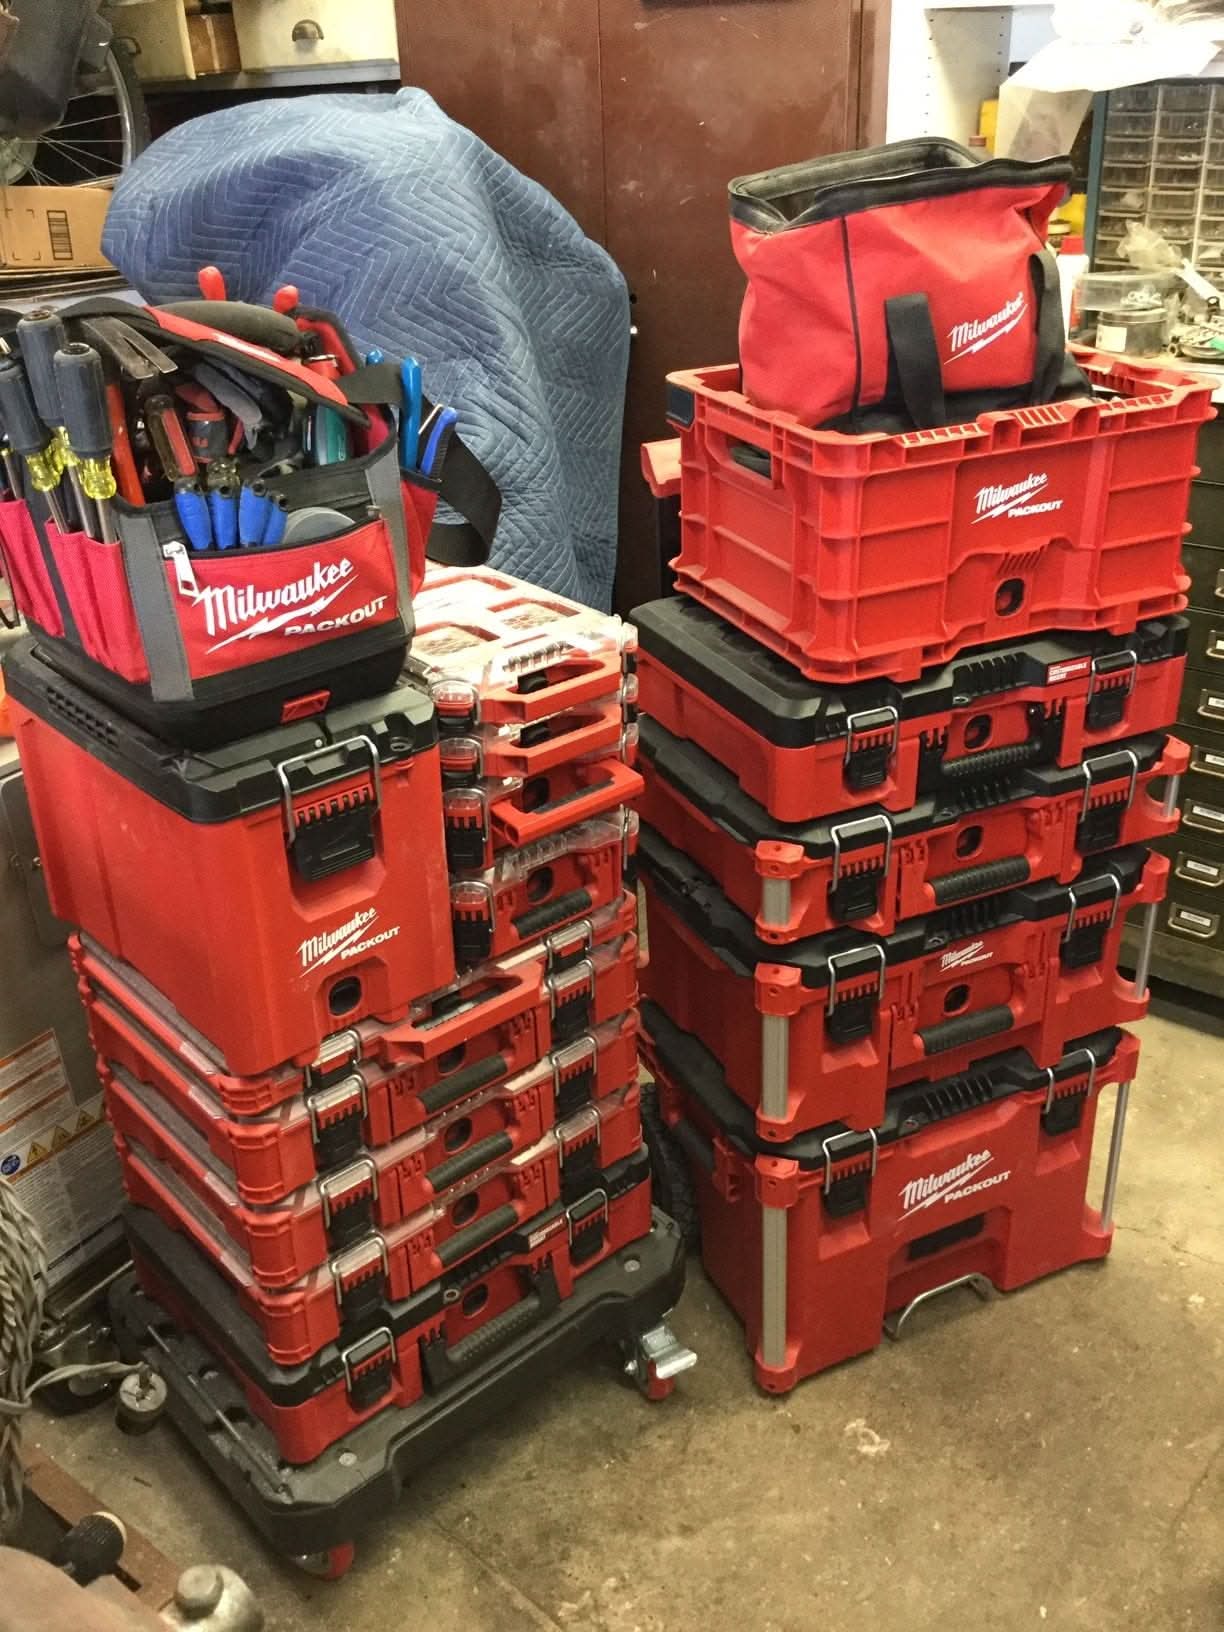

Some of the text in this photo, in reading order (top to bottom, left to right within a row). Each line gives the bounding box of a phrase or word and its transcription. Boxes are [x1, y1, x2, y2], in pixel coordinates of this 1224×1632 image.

[973, 472, 1048, 515] Milwaukee
[191, 557, 354, 636] Milwaukee
[284, 595, 388, 636] PACKOUT
[296, 907, 377, 967] Milwaukee
[341, 926, 401, 960] PACKOUT
[898, 1149, 992, 1209] Milwaukee
[944, 1170, 1011, 1204] PACKOUT
